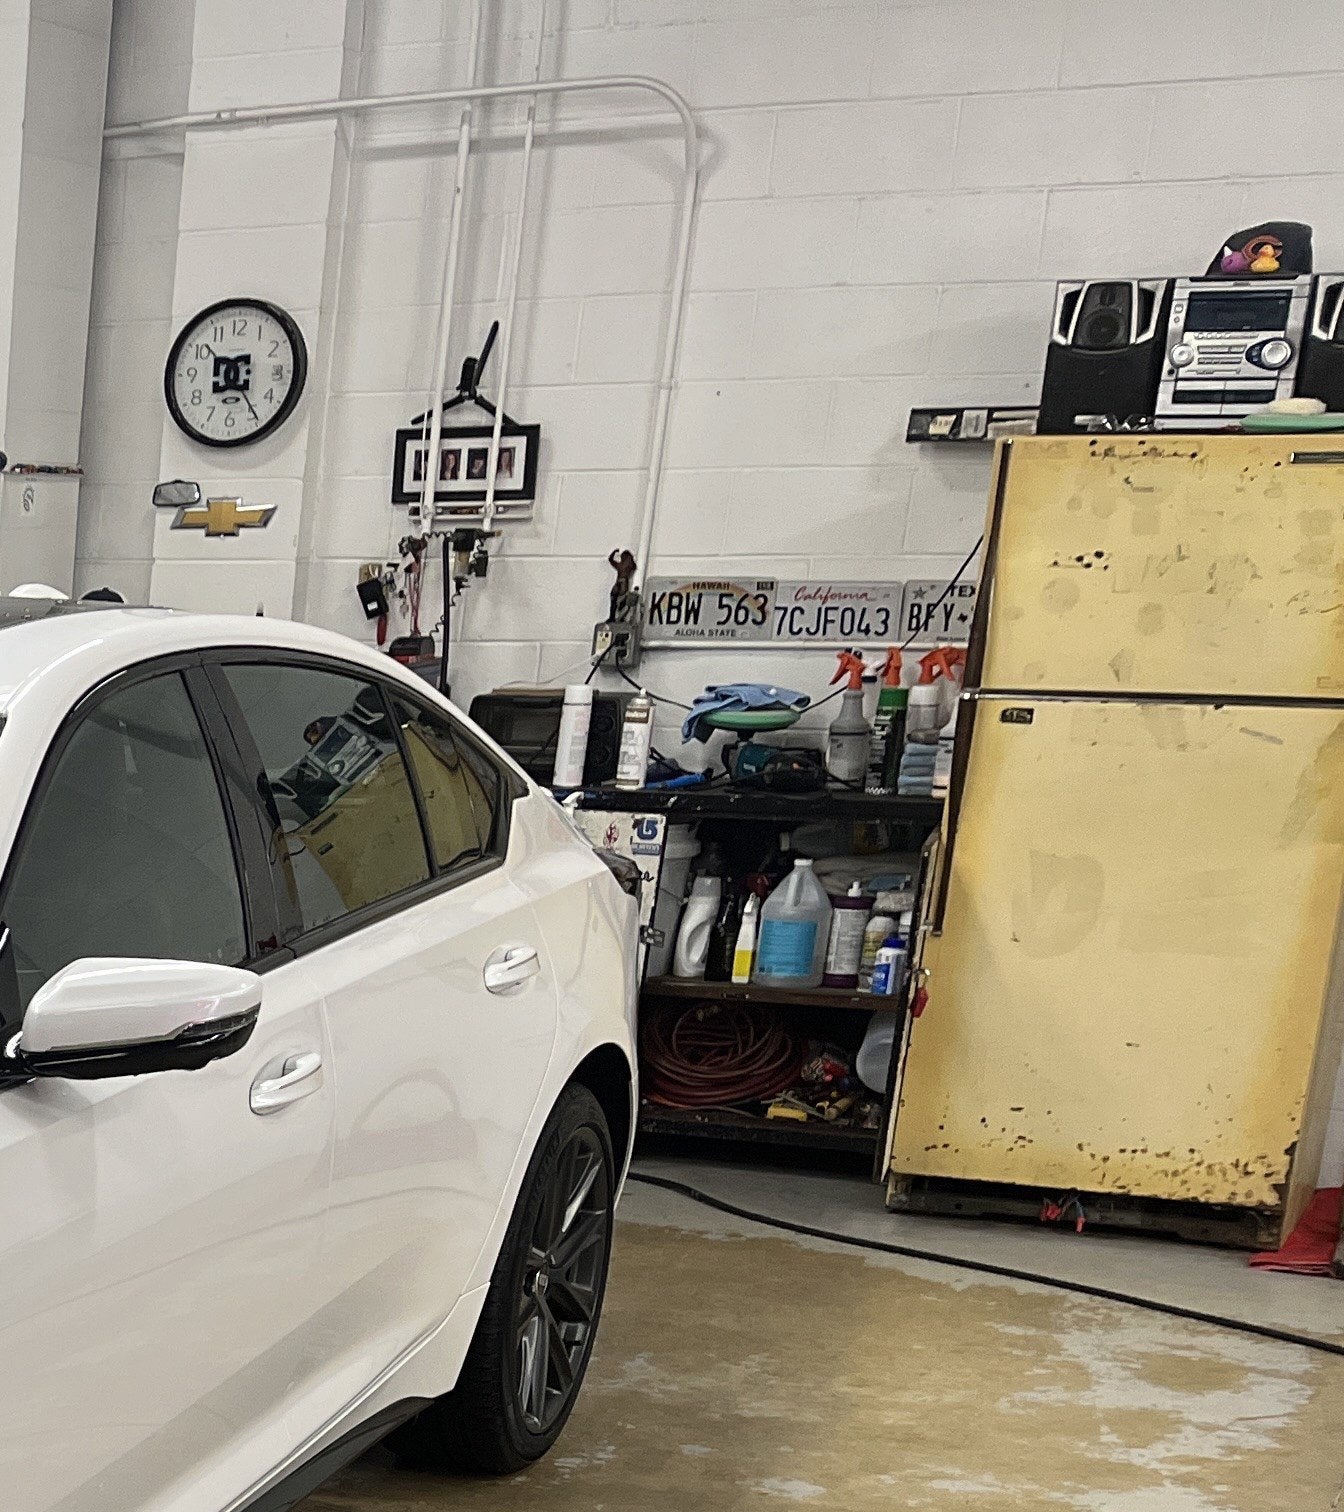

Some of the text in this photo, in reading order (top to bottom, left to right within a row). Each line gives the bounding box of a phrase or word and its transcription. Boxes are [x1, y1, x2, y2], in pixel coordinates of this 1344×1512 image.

[213, 326, 224, 343] 11
[232, 319, 248, 336] 12
[257, 325, 263, 342] 1
[195, 343, 211, 360] 10
[267, 340, 279, 358] 2
[187, 367, 198, 383] 9
[191, 389, 202, 406] 8
[263, 387, 274, 404] 4
[207, 406, 216, 422] 7
[224, 411, 235, 427] 6
[692, 581, 730, 590] HAWAII
[794, 585, 874, 605] California
[649, 592, 768, 626] KBW 563
[774, 606, 890, 636] 7CJF043
[674, 628, 736, 637] ALOHA STATE
